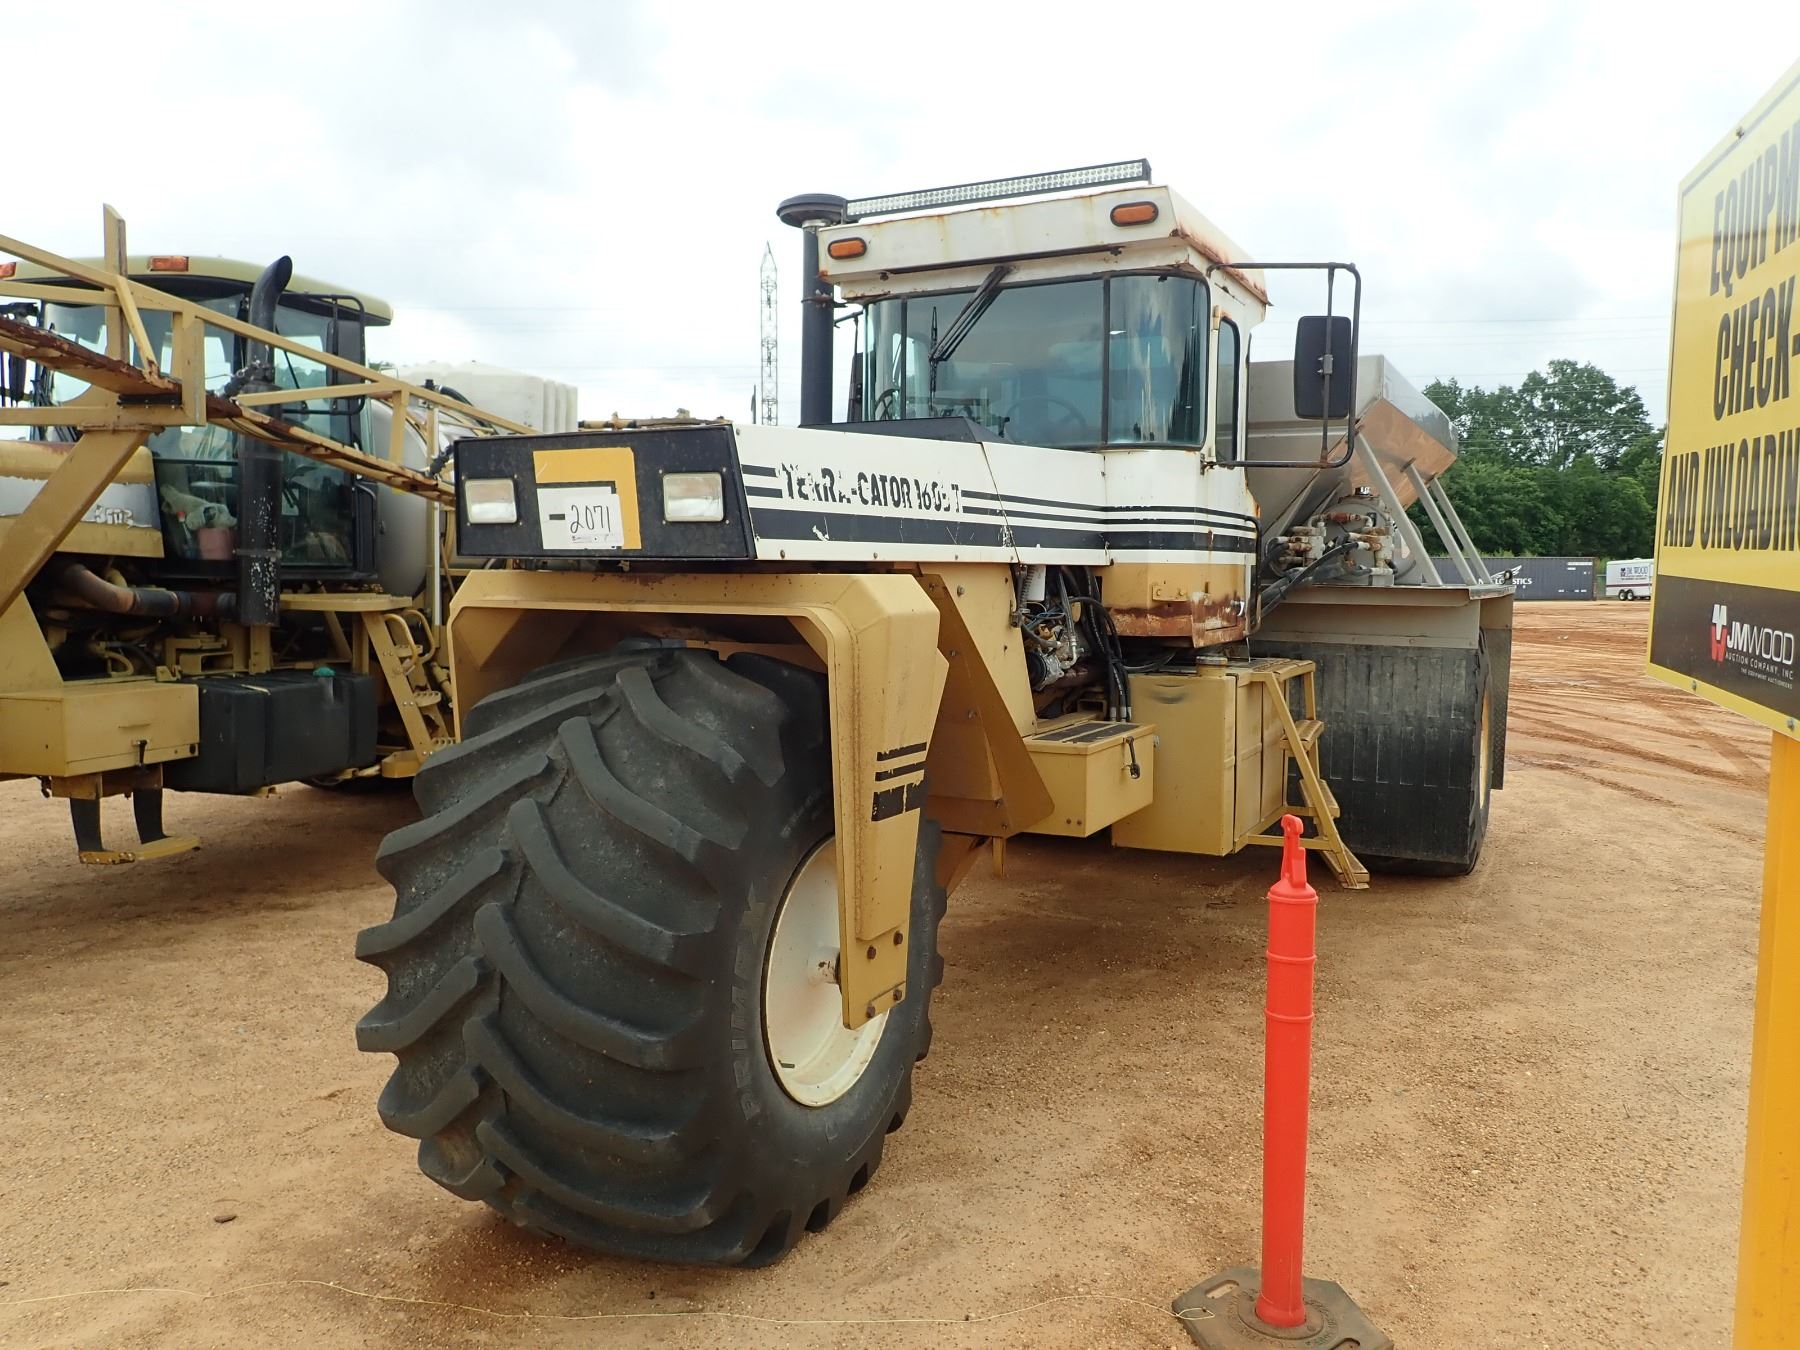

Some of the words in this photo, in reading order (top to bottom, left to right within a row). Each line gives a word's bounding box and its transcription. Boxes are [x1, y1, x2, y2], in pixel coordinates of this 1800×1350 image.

[1710, 117, 1800, 299] EQUIPM
[570, 504, 611, 534] 2071
[1663, 451, 1699, 548] AND
[1700, 427, 1800, 551] UNLOADIN
[1725, 651, 1749, 665] AUCTION
